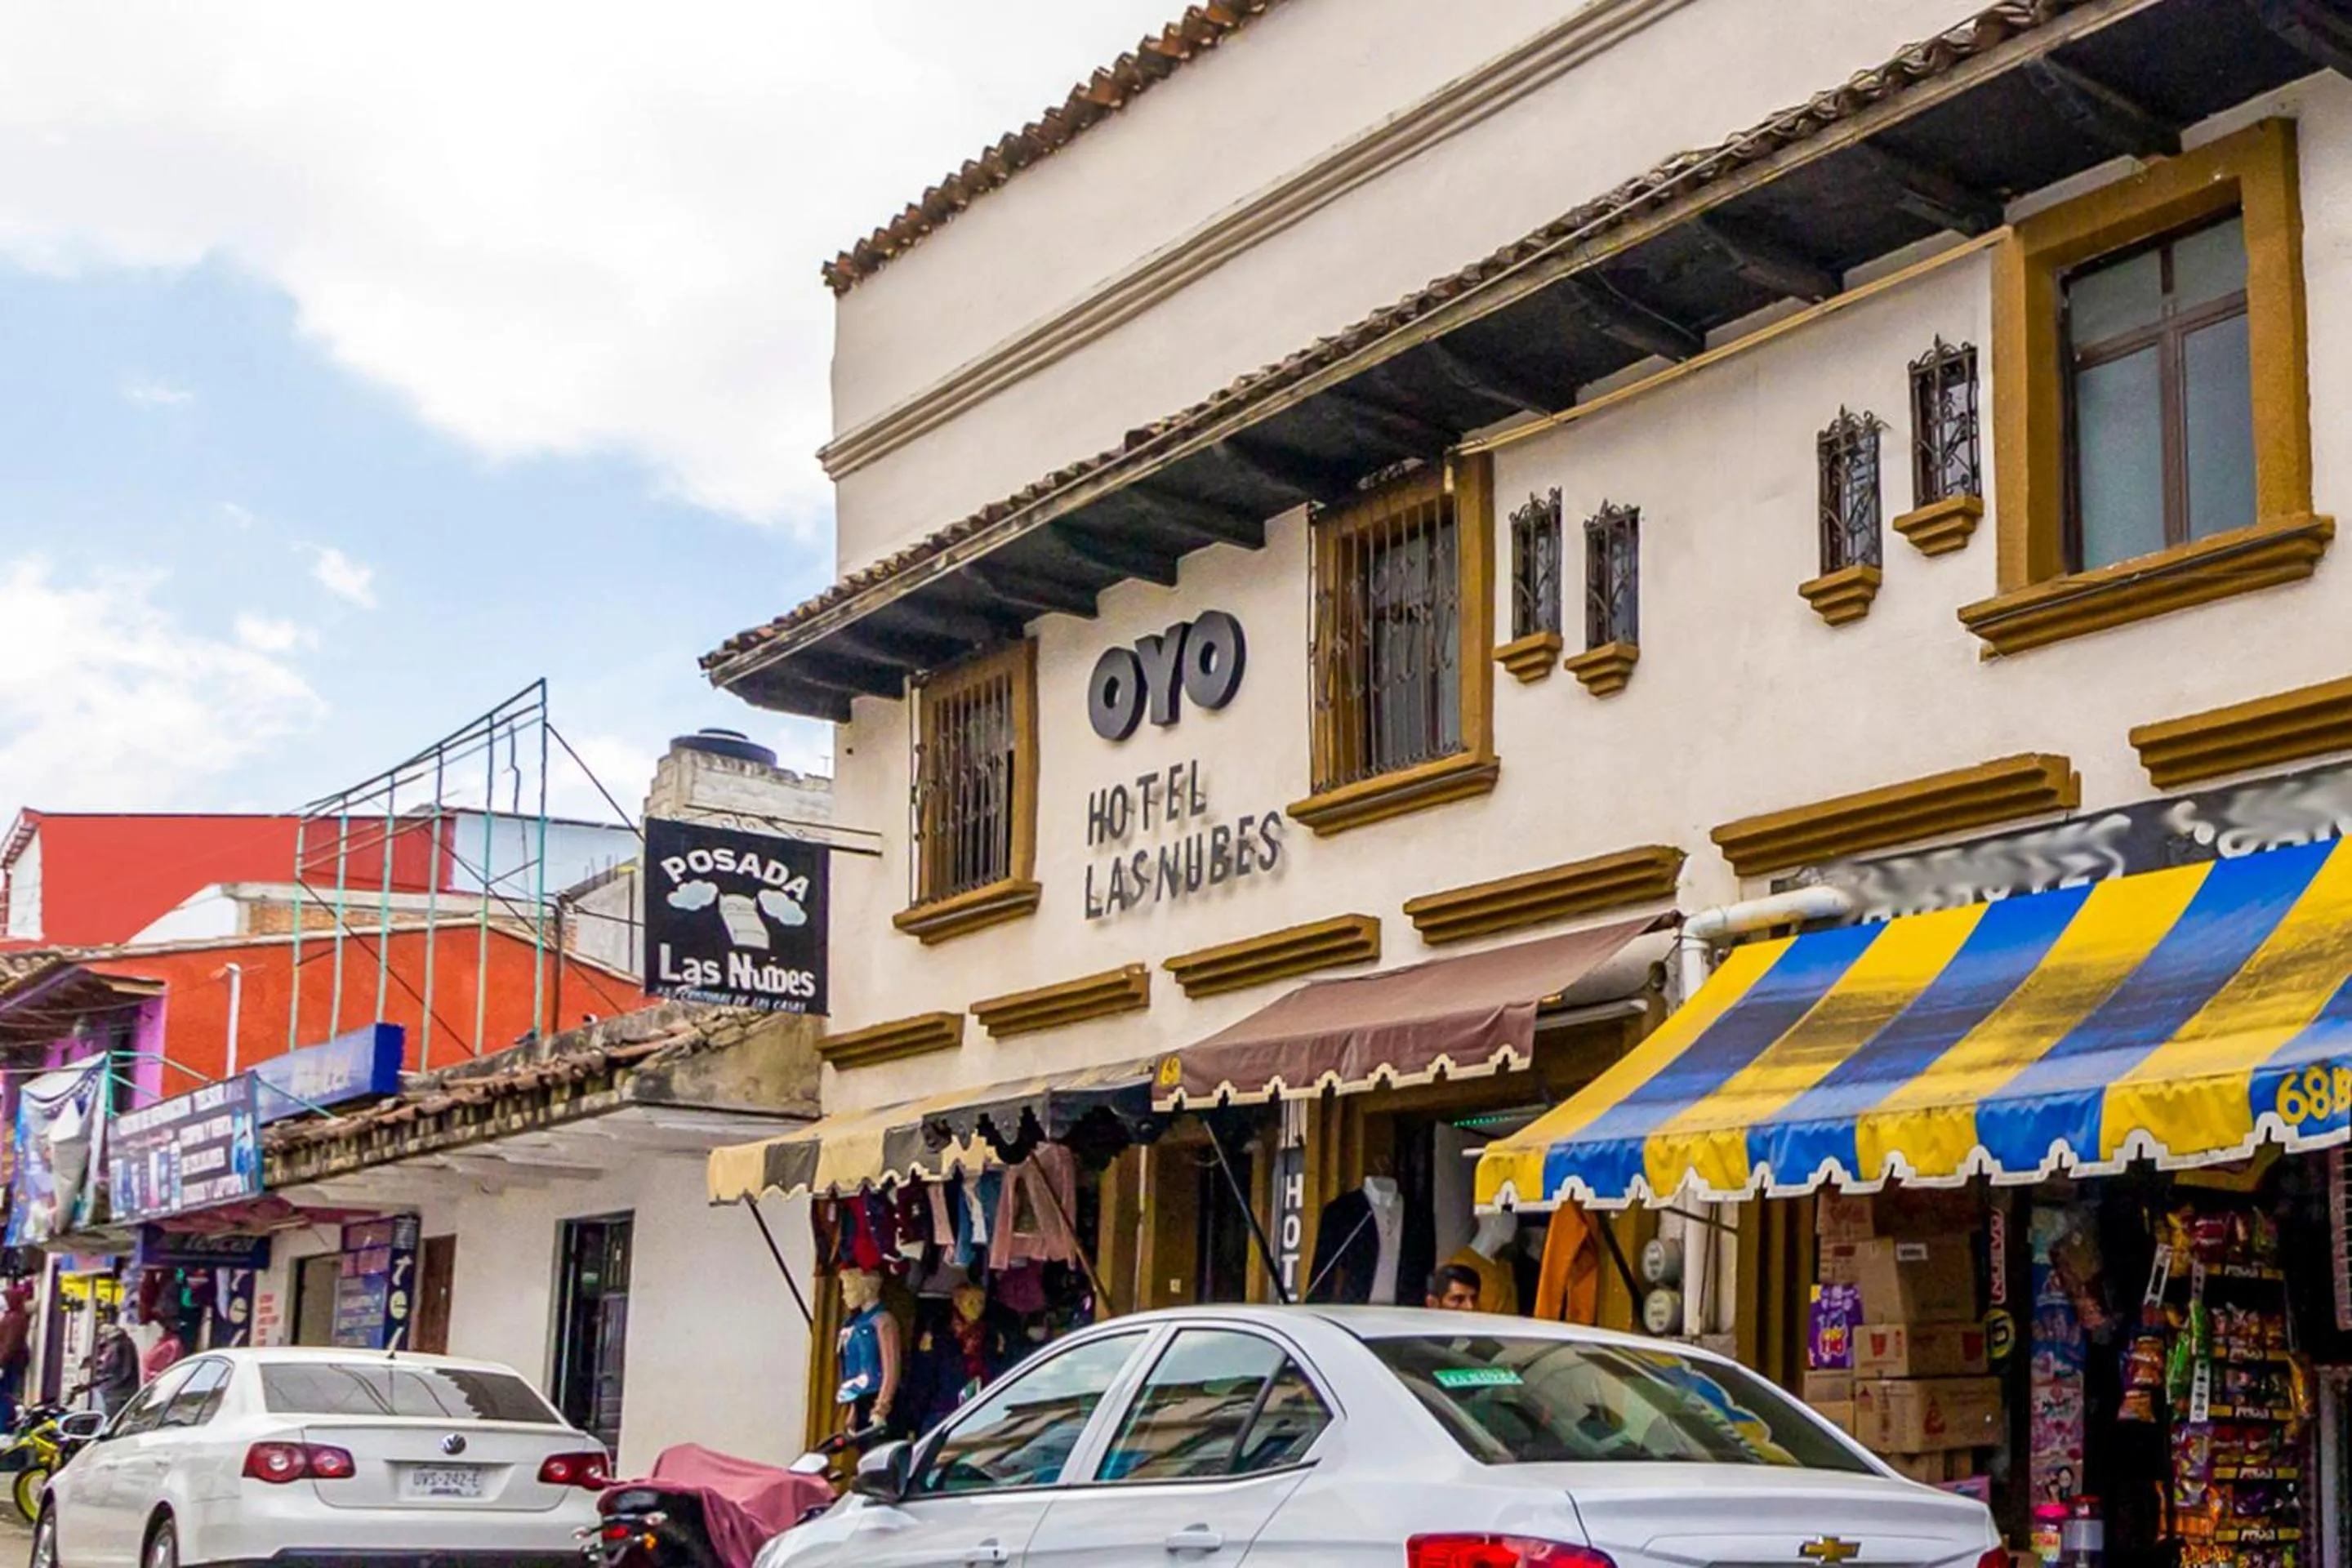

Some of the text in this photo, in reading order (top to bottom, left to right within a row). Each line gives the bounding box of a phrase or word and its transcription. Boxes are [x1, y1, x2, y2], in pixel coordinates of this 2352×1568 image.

[1088, 610, 1246, 741] OYO
[1087, 760, 1207, 846] HOTEL
[660, 848, 811, 902] POSADA
[659, 943, 721, 987] Las
[1281, 1173, 1304, 1301] HOT
